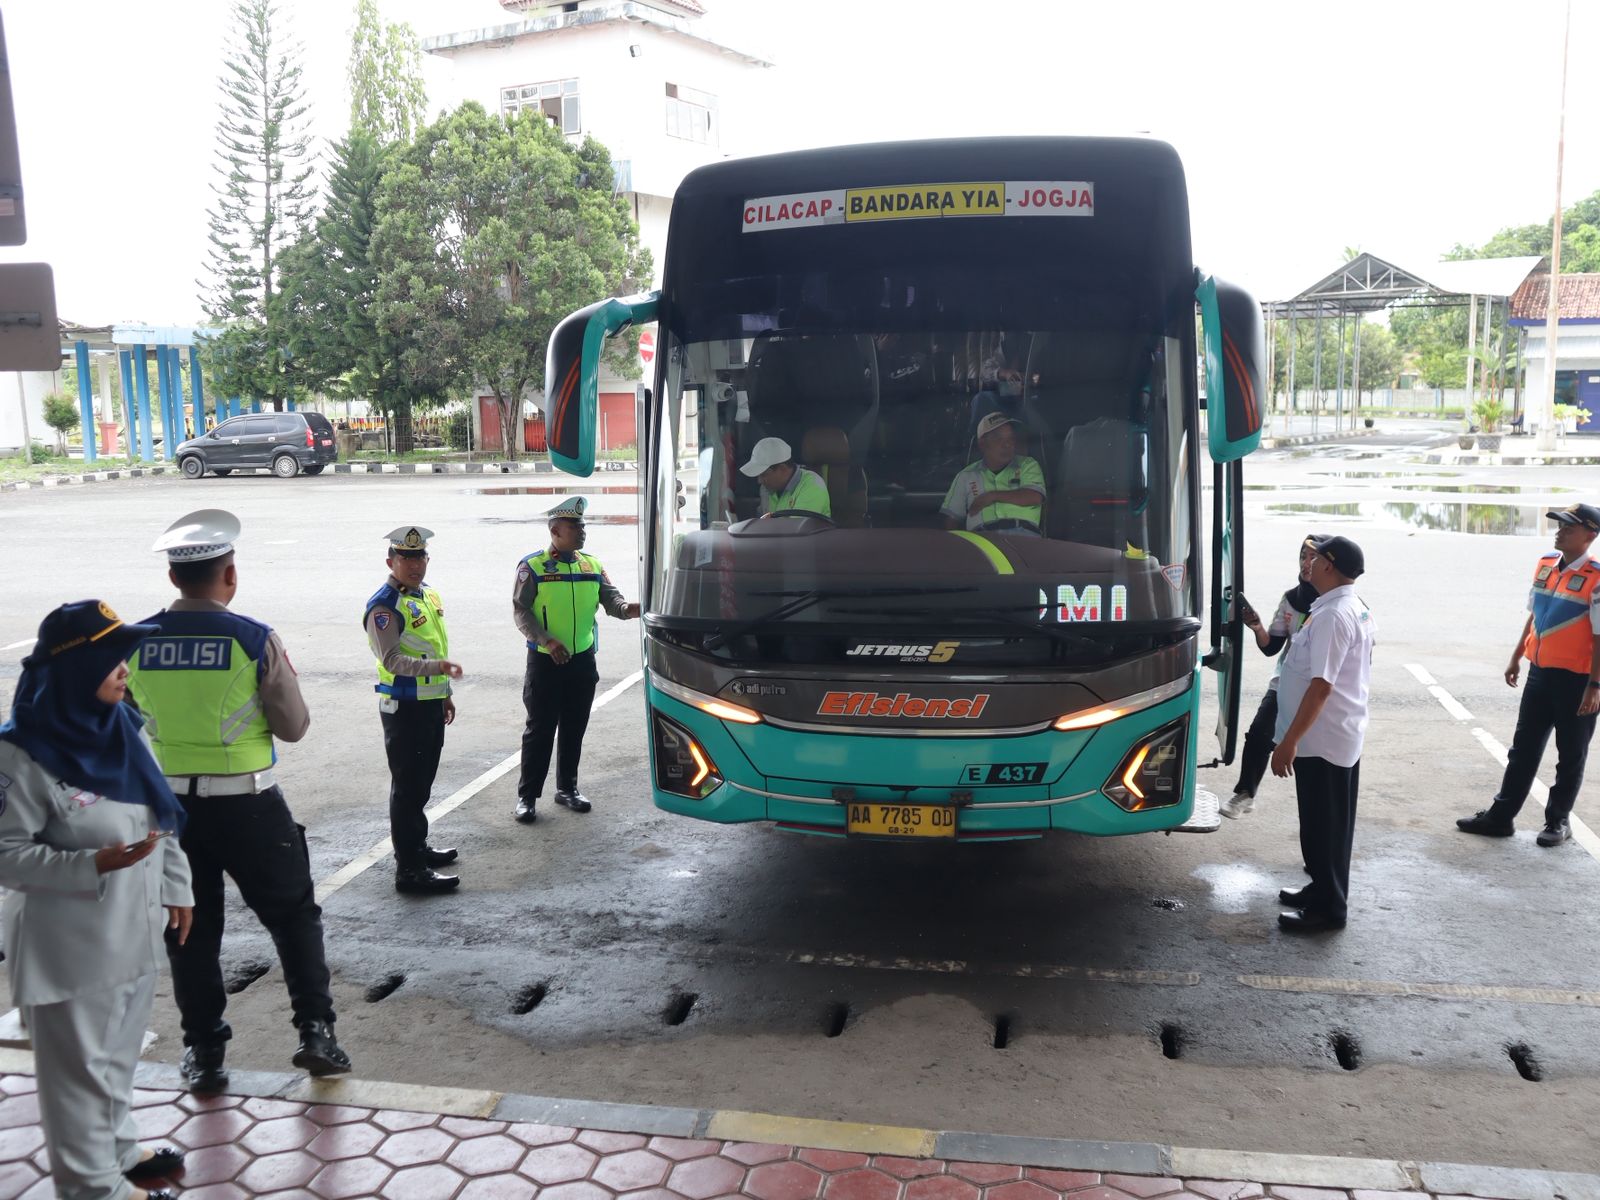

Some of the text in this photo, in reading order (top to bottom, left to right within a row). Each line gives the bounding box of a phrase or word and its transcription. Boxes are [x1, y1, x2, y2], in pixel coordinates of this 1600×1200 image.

[743, 199, 832, 225] CILACAP
[850, 190, 955, 215] BANDARA
[961, 189, 1000, 209] YIA
[1017, 189, 1093, 209] JOGJA
[143, 642, 225, 666] POLISI
[817, 691, 990, 719] Efisiensi
[968, 766, 1037, 781] E 437
[851, 805, 871, 824] AA
[880, 806, 922, 826] 7785
